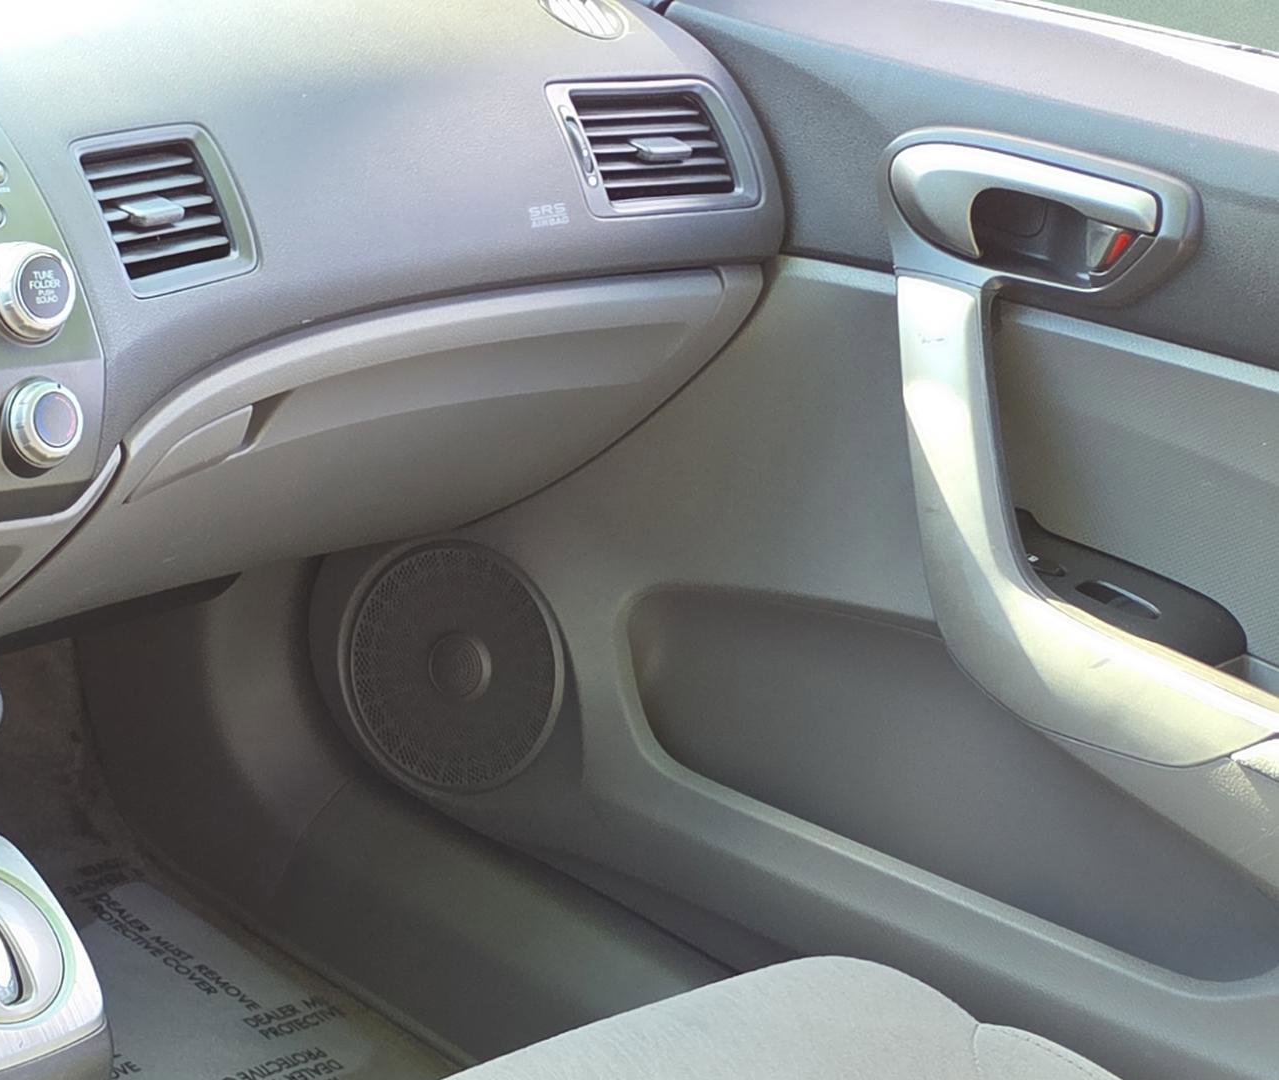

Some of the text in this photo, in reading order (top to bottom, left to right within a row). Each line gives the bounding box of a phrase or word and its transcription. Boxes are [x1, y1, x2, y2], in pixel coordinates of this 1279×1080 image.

[529, 202, 566, 217] SRS
[29, 279, 60, 289] FOLDER
[32, 270, 54, 280] TUNE
[95, 892, 262, 1012] DEALER MUST REMOVE
[162, 956, 219, 996] COVER
[242, 1003, 302, 1029] DEALER
